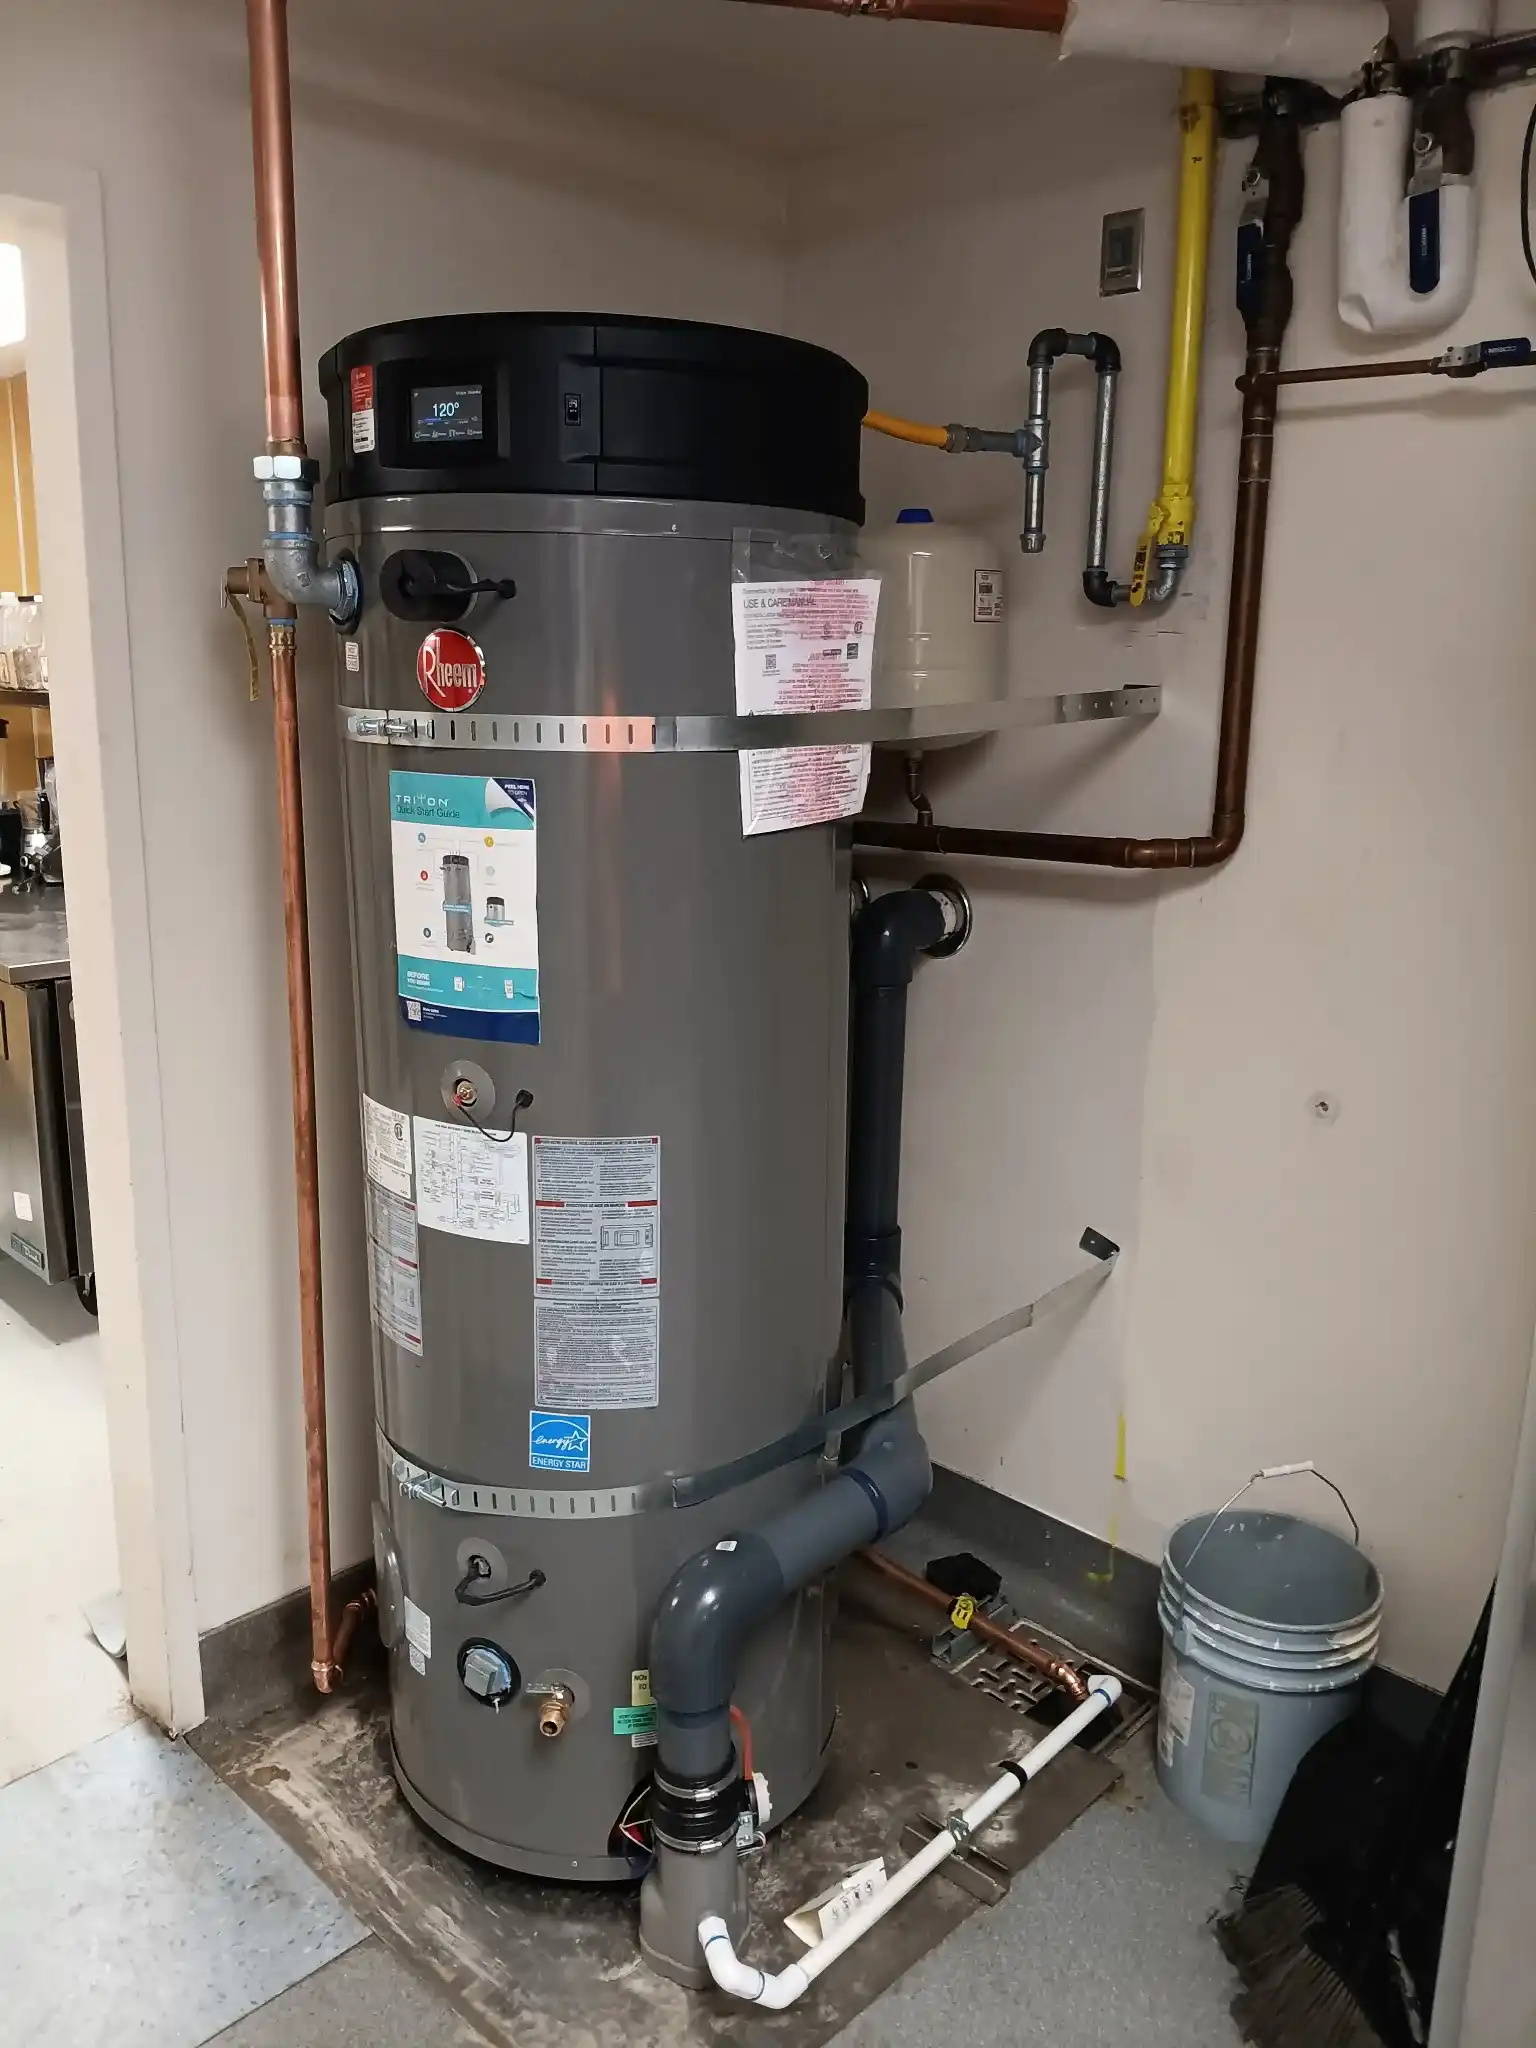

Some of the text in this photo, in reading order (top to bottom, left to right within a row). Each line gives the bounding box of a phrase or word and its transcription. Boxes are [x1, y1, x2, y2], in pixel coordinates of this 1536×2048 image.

[743, 599, 758, 609] USE
[761, 599, 769, 609] &
[422, 636, 478, 698] Rheem
[395, 804, 461, 819] Quick Start Guide
[532, 1456, 587, 1469] ENERGY STAR
